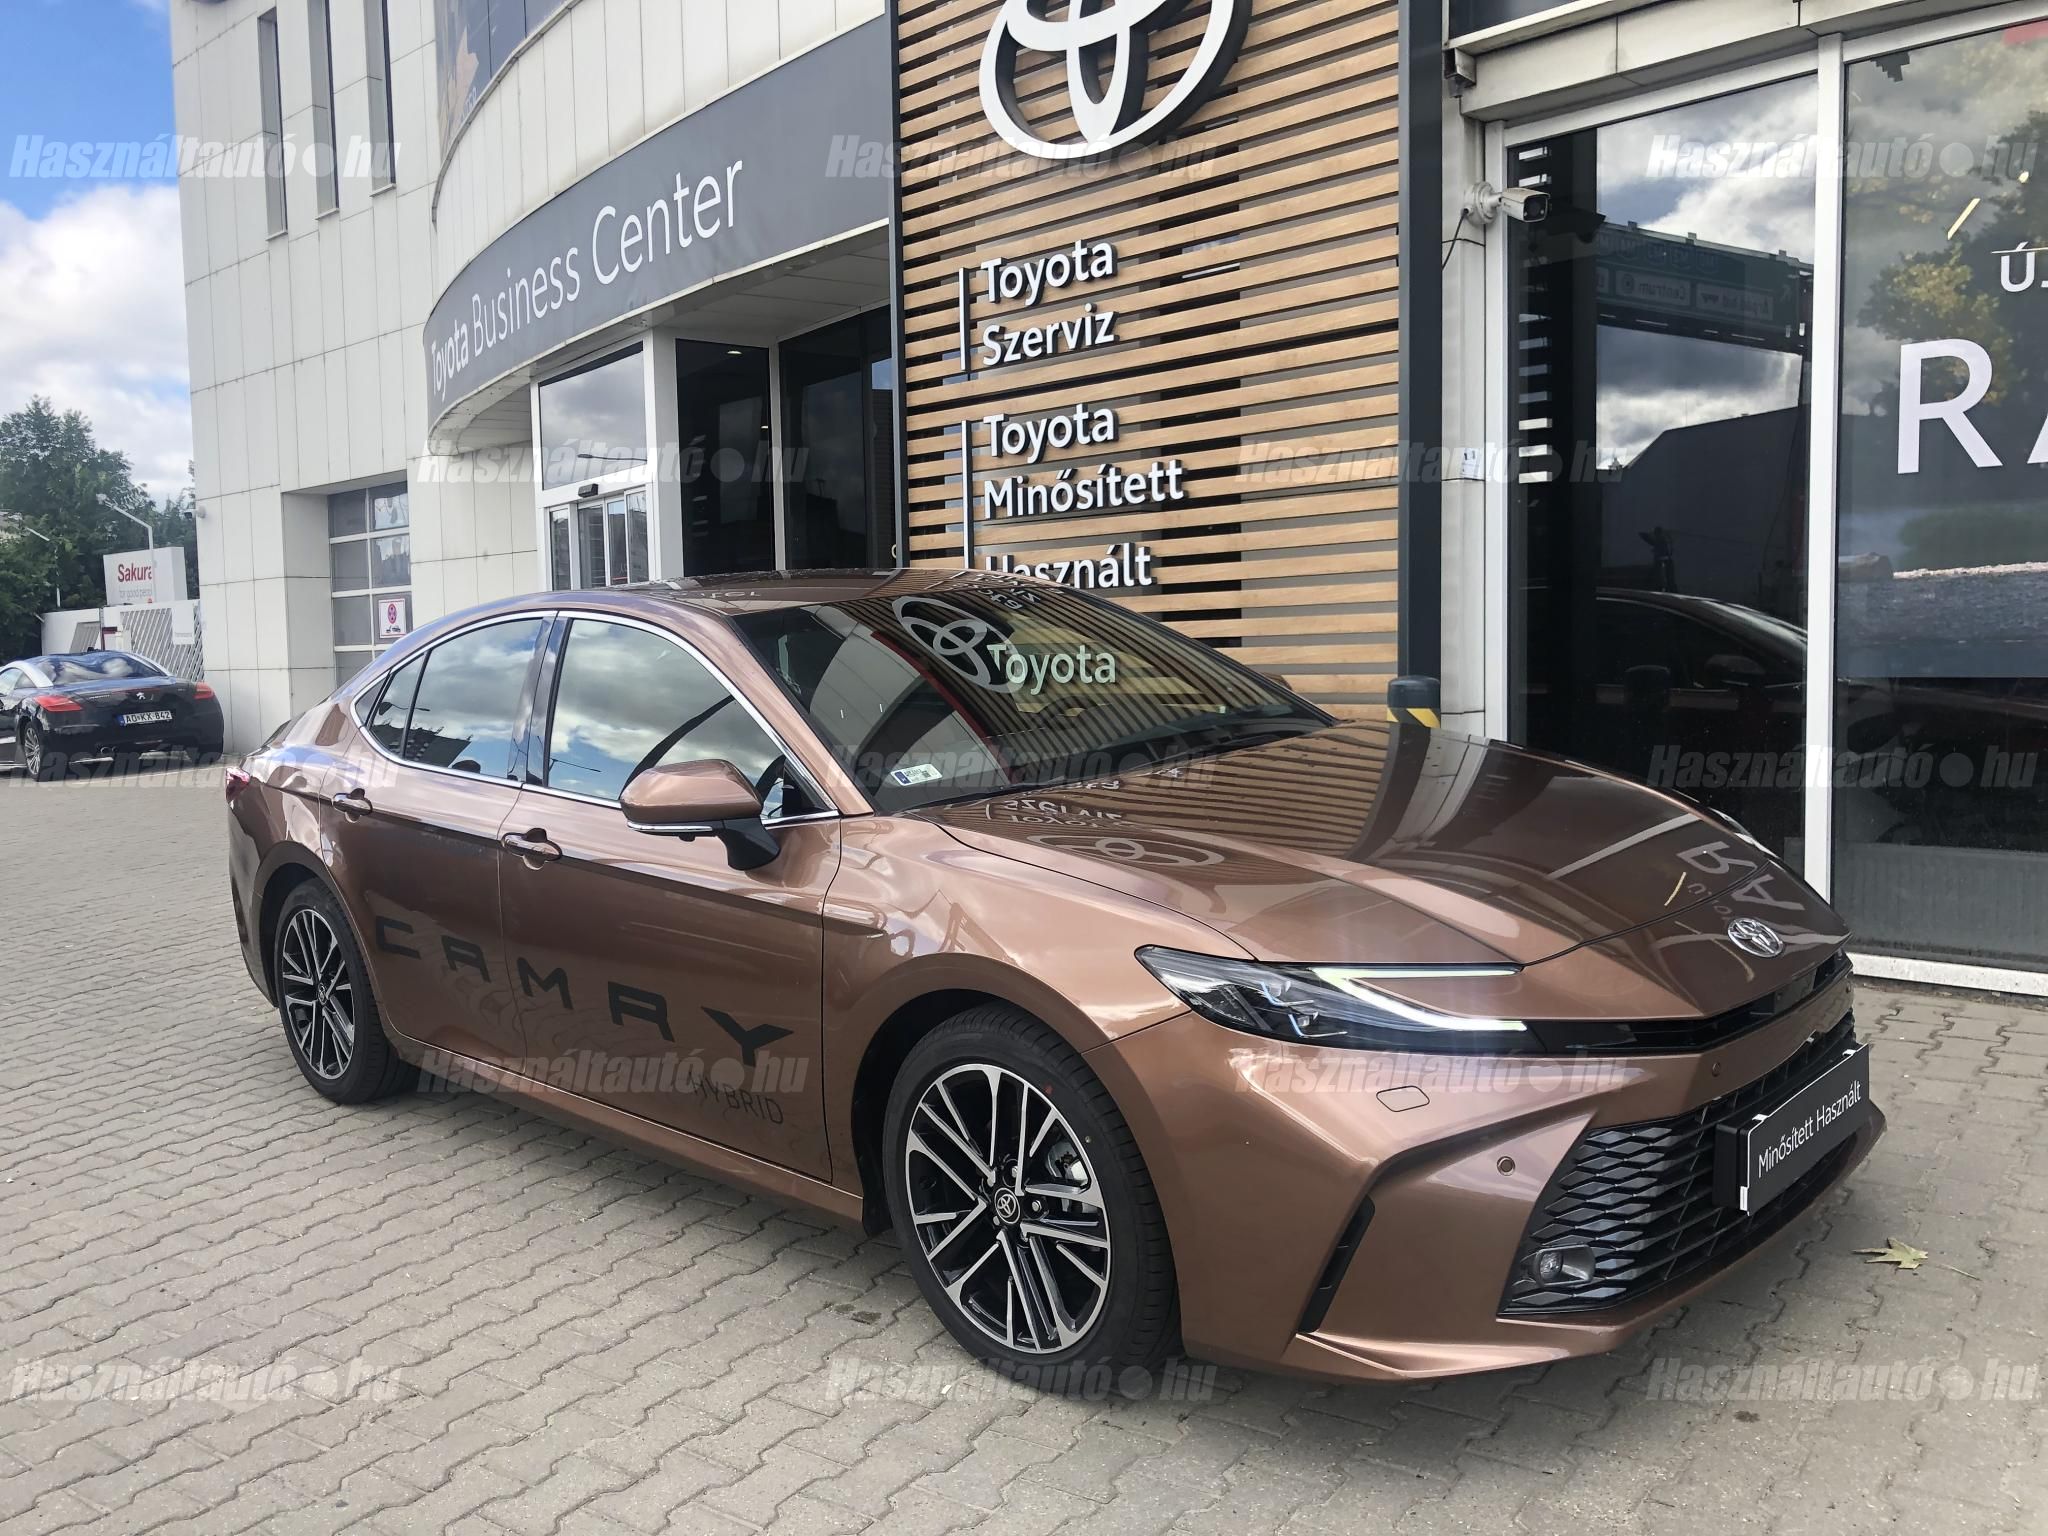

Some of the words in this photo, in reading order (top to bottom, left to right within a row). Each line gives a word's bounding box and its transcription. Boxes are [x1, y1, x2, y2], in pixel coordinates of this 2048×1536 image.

[432, 317, 470, 402] Toyota
[472, 247, 580, 357] Business
[592, 160, 743, 285] Center
[981, 240, 1115, 305] Toyota
[983, 303, 1115, 366] Szerviz
[984, 404, 1116, 464] Toyota
[984, 459, 1184, 520] Minősített
[987, 644, 1117, 695] Toyota
[375, 915, 795, 1068] CAMRY
[689, 1070, 784, 1125] HYBRID
[1758, 1116, 1814, 1179] Minősített
[1816, 1079, 1862, 1132] Használt
